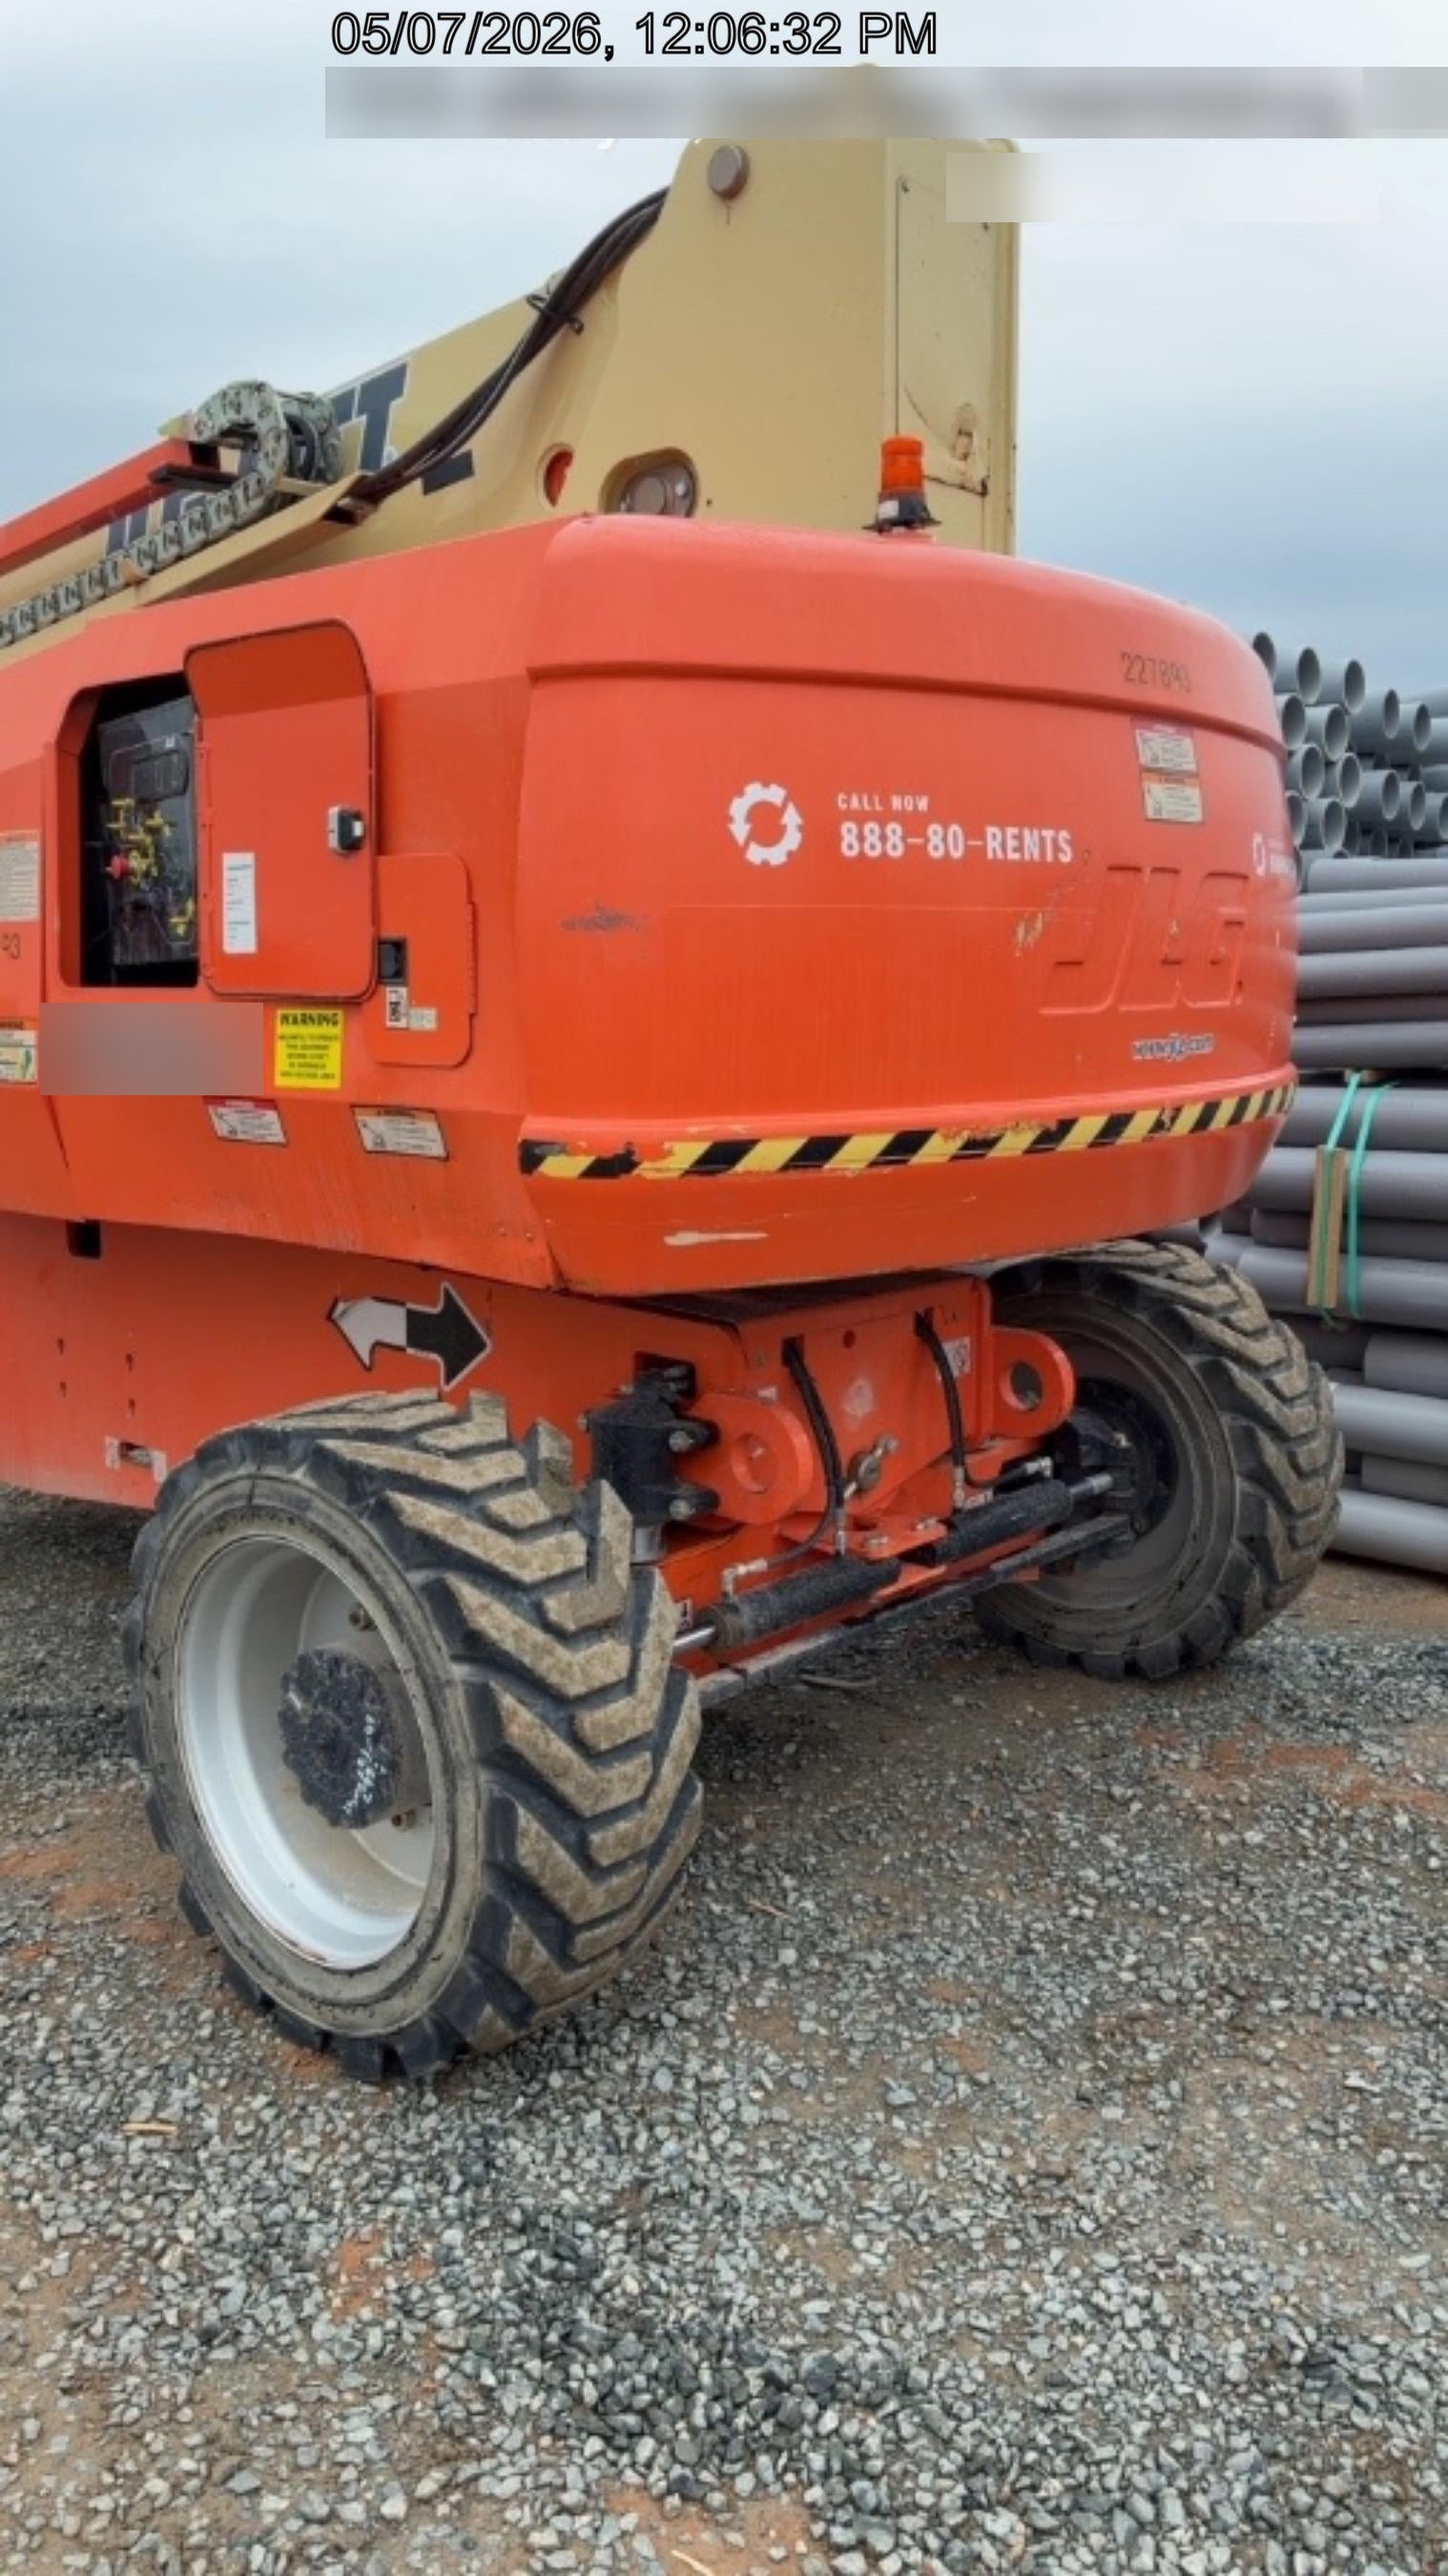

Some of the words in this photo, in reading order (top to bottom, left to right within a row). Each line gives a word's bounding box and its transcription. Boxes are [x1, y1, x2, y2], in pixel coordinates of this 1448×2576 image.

[837, 792, 883, 811] CALL
[892, 795, 929, 813] NOW
[840, 821, 1072, 862] 888-80-RENTS
[1038, 863, 1249, 1014] JLG
[280, 1012, 340, 1027] WARNING
